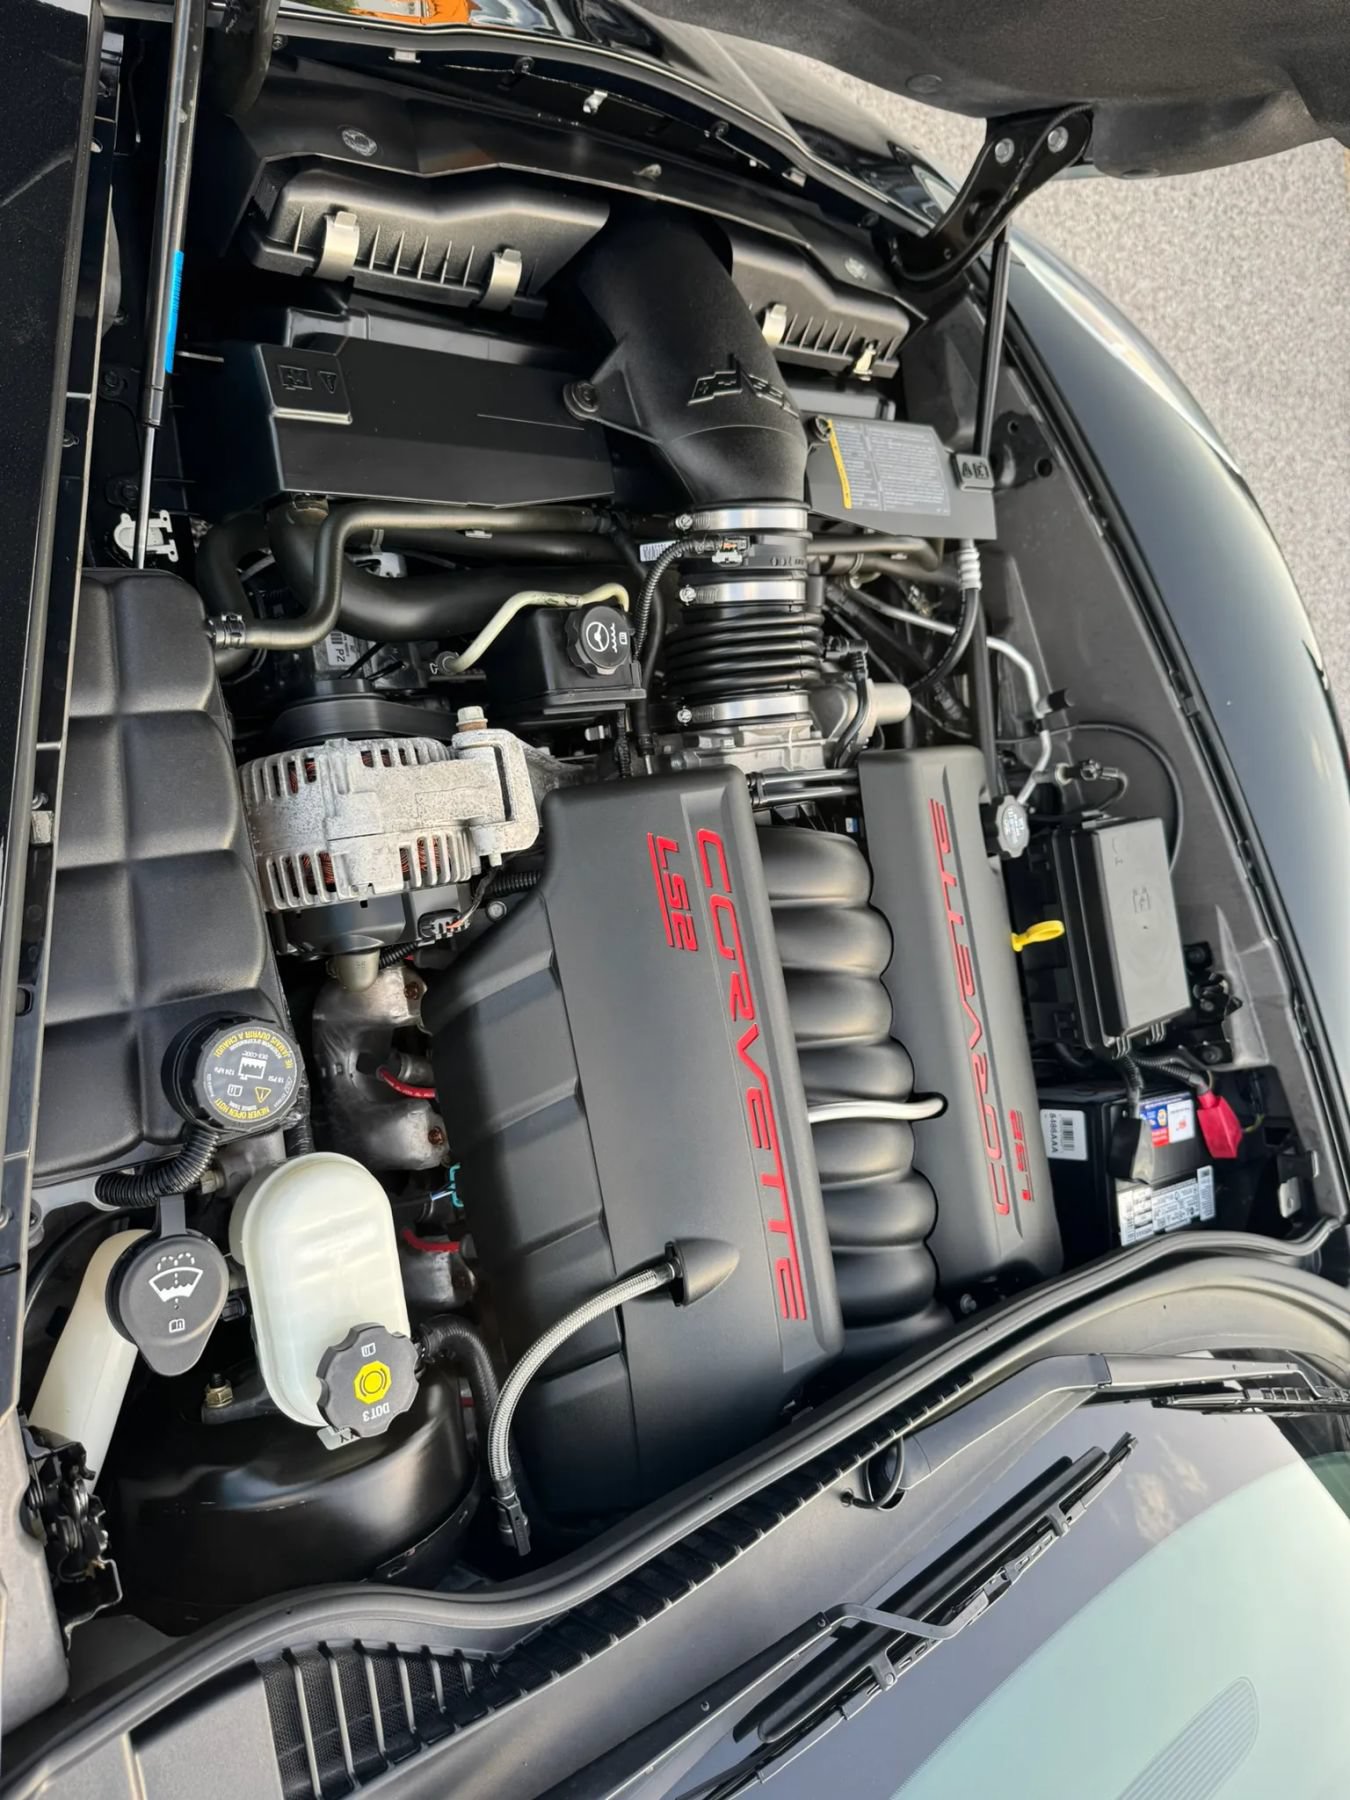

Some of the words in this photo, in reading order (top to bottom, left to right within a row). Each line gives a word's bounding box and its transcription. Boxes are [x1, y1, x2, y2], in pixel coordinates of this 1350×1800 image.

[336, 648, 345, 662] PZ
[647, 832, 698, 951] LS2
[929, 798, 1010, 1216] CORVETTE
[246, 1030, 271, 1040] OUVRIR
[697, 828, 807, 1321] CORVETTE
[214, 1098, 230, 1114] HOT!
[229, 1109, 247, 1119] OPEN
[246, 1105, 270, 1119] NEVER
[1009, 1110, 1035, 1202] LS2
